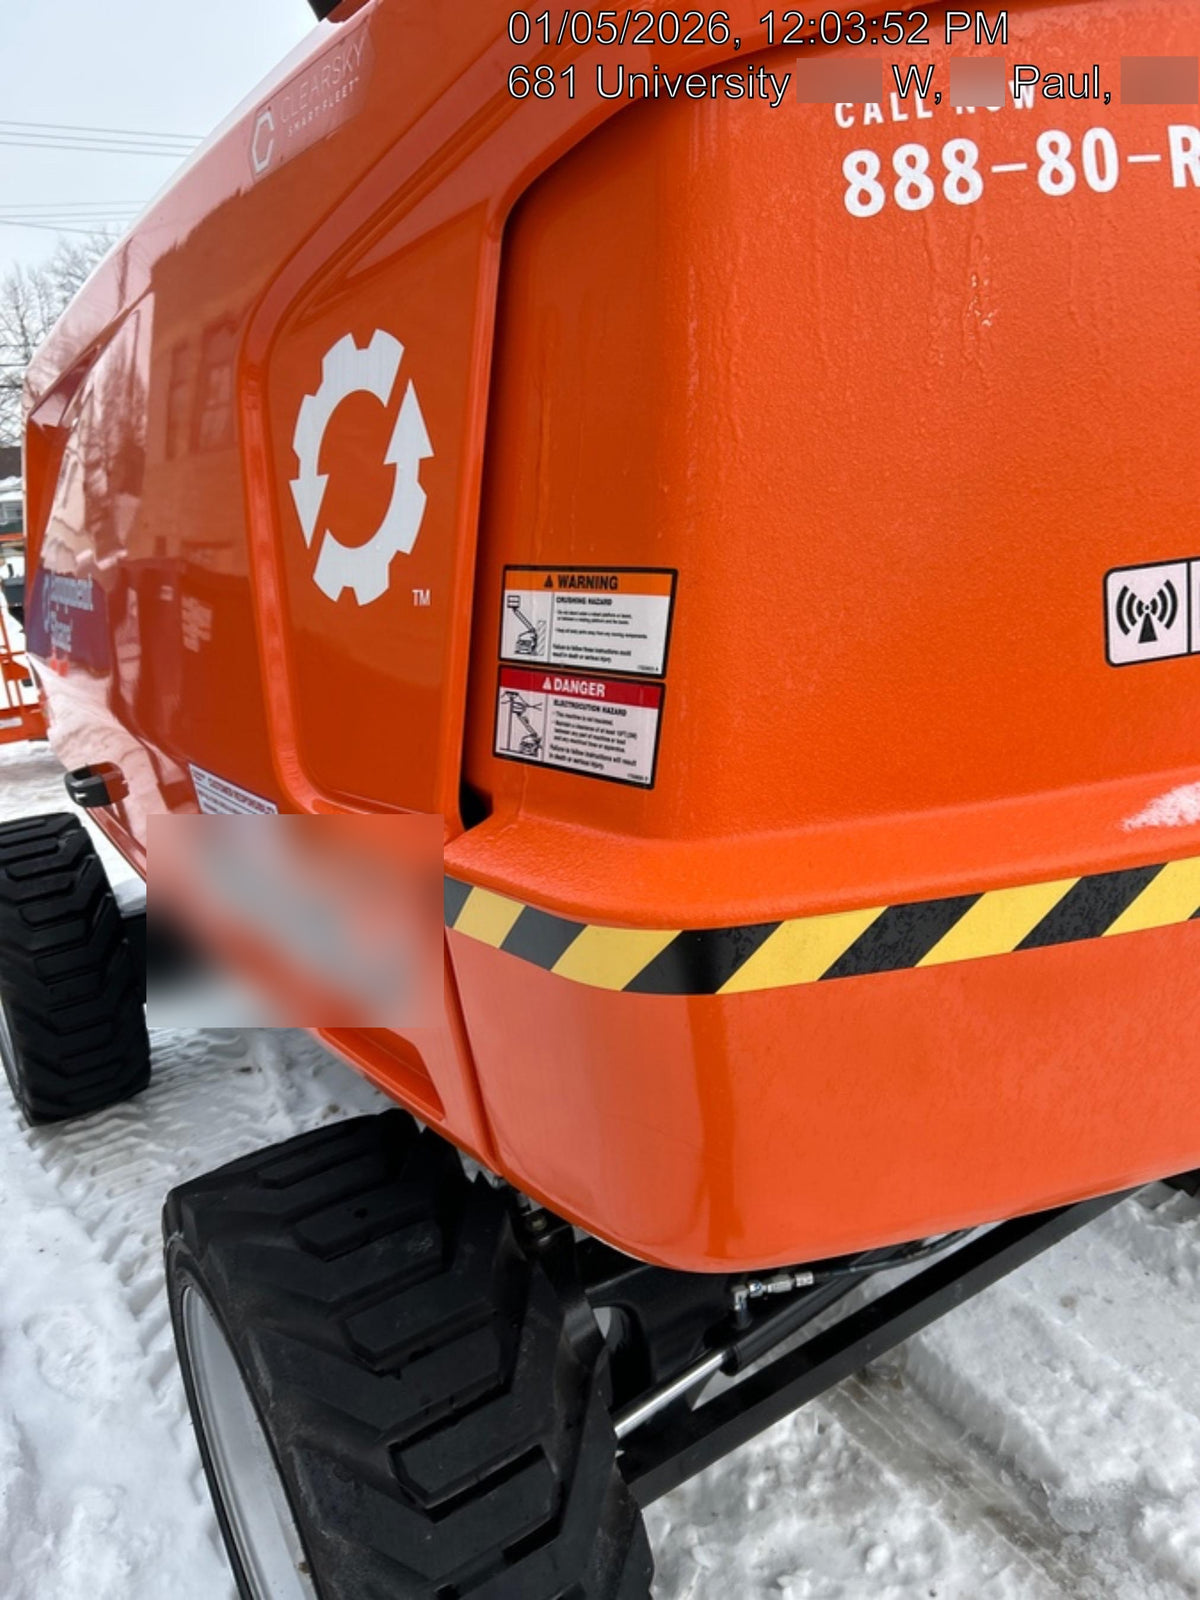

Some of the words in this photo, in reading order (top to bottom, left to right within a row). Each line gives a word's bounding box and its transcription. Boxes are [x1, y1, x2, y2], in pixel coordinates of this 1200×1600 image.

[280, 36, 366, 123] CLEARSKY
[834, 89, 933, 128] CALL
[557, 575, 619, 590] WARNING
[411, 589, 431, 607] TM
[556, 597, 586, 605] CRUSHING
[588, 598, 612, 606] HAZARD
[553, 677, 606, 698] DANGER
[553, 699, 600, 713] ELECTROCUTION
[602, 706, 628, 717] HAZARD
